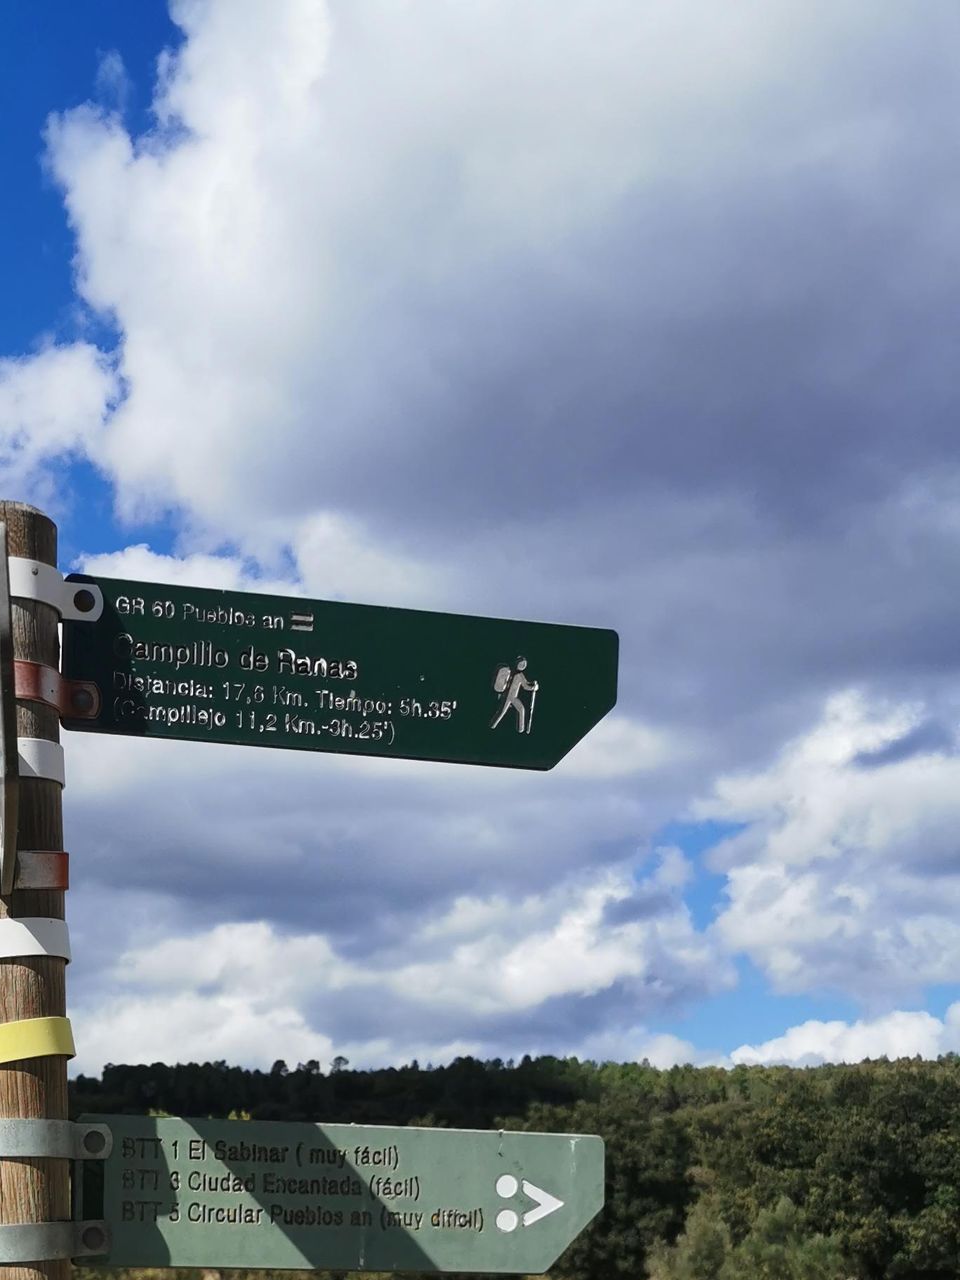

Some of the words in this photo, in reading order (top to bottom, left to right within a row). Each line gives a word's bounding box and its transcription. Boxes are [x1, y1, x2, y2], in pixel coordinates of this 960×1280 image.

[116, 596, 144, 615] GR
[152, 601, 175, 618] 60
[183, 603, 255, 627] Pueblos
[262, 614, 284, 630] an
[114, 633, 229, 670] Campillo
[240, 645, 269, 672] de
[277, 648, 358, 680] Ranas
[113, 671, 214, 699] Distancia:
[223, 681, 265, 704] 17,6
[272, 685, 308, 707] Km.
[315, 689, 392, 716] Tiempo:
[236, 711, 277, 732] 11,2
[121, 1137, 163, 1160] BTT
[171, 1140, 180, 1160] 1
[189, 1139, 206, 1160] El
[214, 1140, 289, 1164] Sabinar
[310, 1148, 347, 1169] muy
[354, 1145, 399, 1170] fácil)
[121, 1169, 162, 1191] BTT
[169, 1171, 180, 1192] 3
[188, 1171, 256, 1193] Ciudad
[262, 1173, 362, 1195] Encantada
[369, 1174, 420, 1201] (fácil)
[121, 1201, 162, 1223] BTT
[169, 1203, 180, 1223] 5
[188, 1202, 264, 1225] Circular
[270, 1204, 343, 1226] Pueblos
[350, 1209, 372, 1226] an
[380, 1206, 423, 1231] (muy
